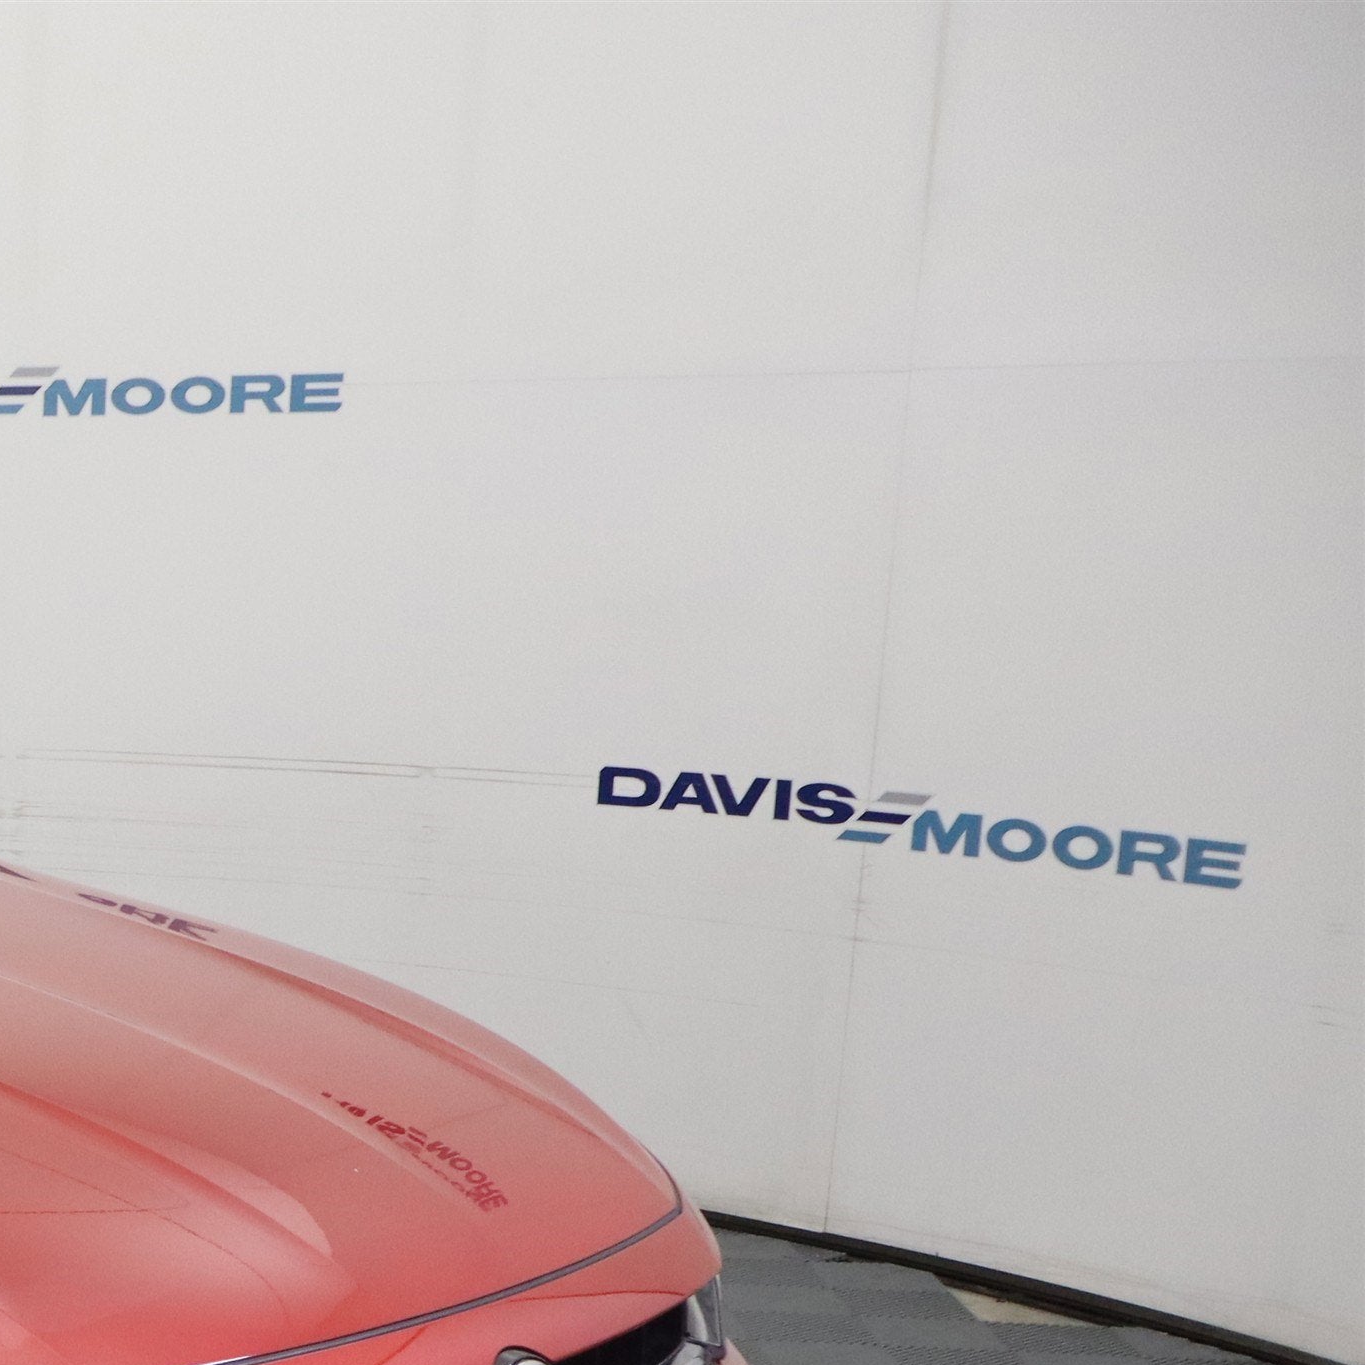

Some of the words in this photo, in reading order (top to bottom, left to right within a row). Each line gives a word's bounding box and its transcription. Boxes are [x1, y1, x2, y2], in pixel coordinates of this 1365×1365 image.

[42, 371, 345, 417] MOORE
[597, 764, 855, 824] DAVIS
[911, 807, 1247, 890] MOORE
